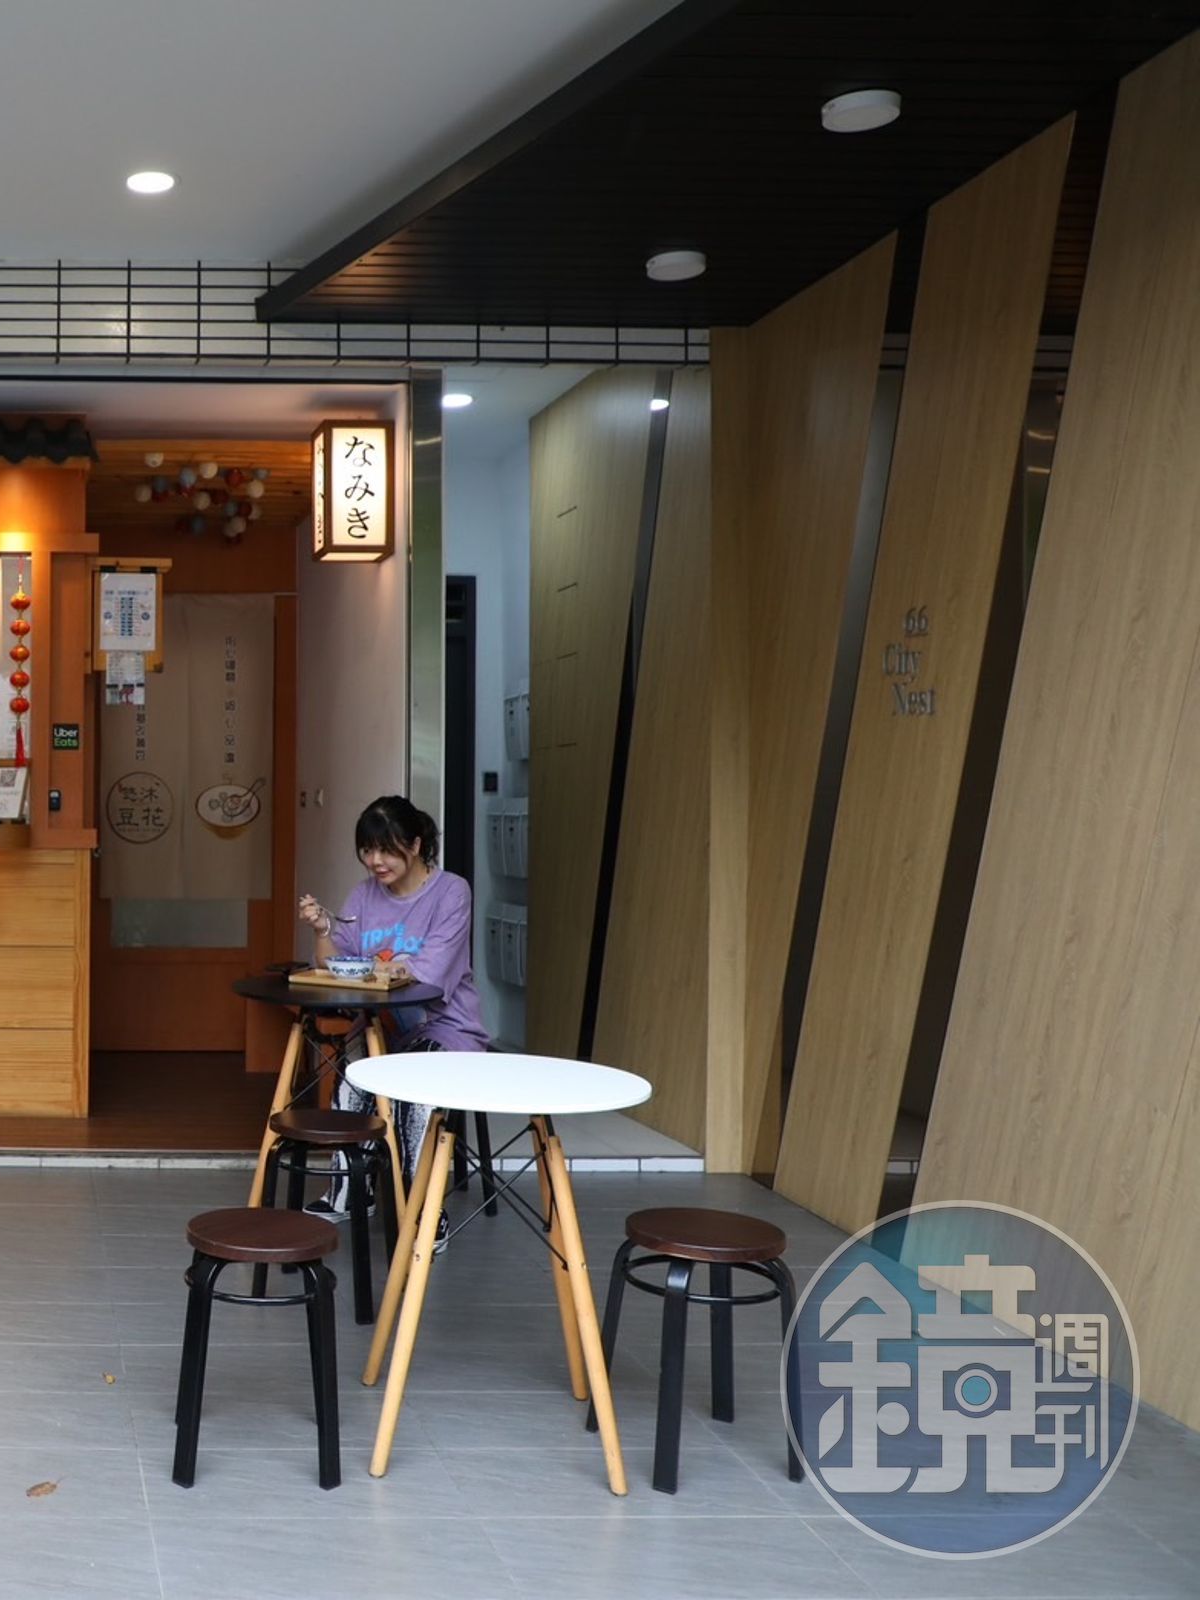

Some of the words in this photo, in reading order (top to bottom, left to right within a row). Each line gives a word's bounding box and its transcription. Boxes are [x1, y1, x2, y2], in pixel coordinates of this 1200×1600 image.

[344, 435, 376, 539] なみき
[904, 605, 929, 633] 66
[882, 642, 921, 683] City
[892, 682, 936, 717] Nest
[54, 727, 78, 738] Uber
[54, 737, 78, 748] Eats
[116, 806, 165, 828] 豆花
